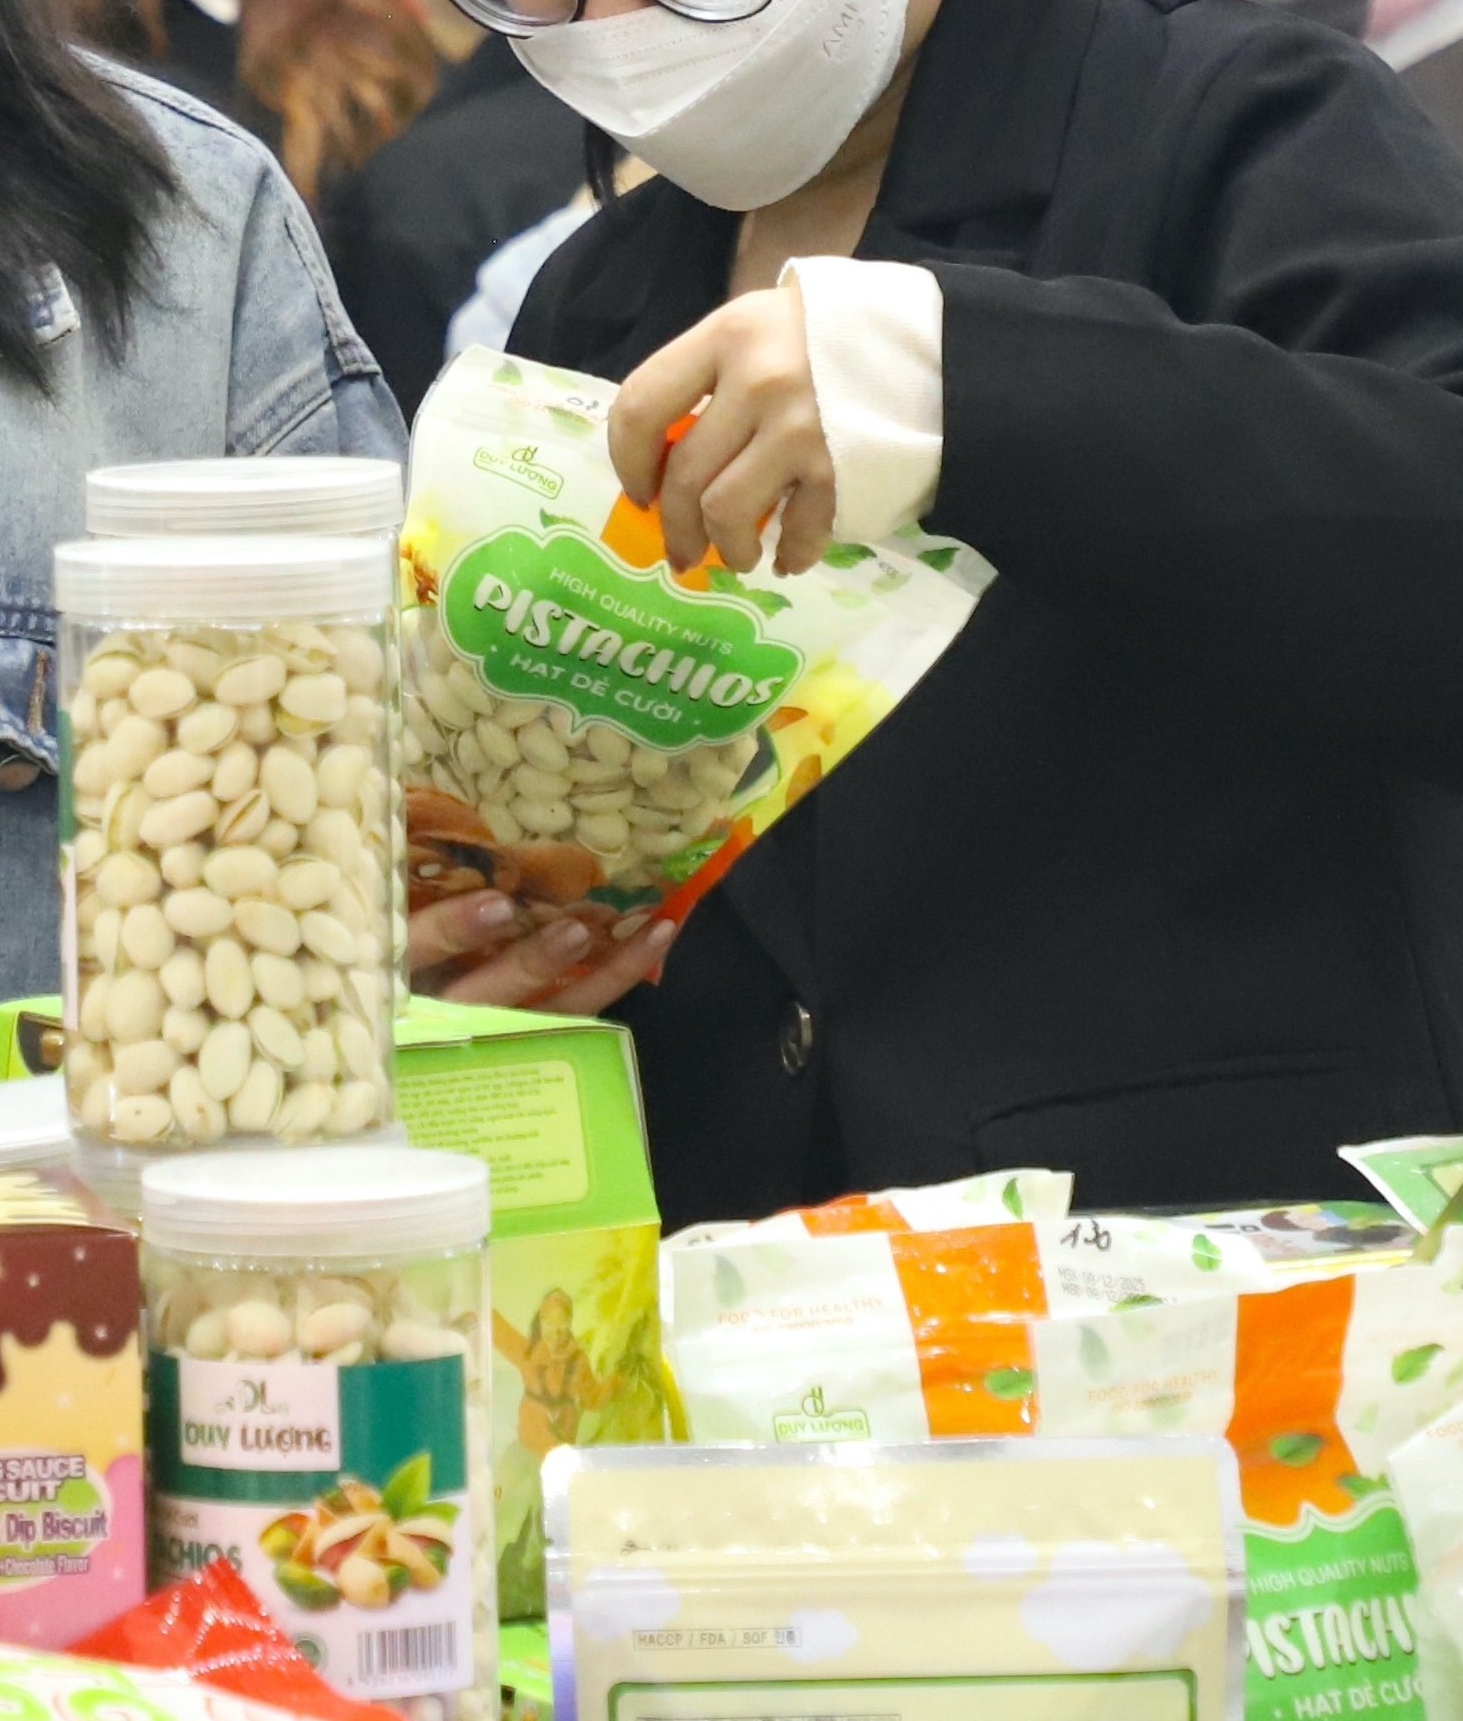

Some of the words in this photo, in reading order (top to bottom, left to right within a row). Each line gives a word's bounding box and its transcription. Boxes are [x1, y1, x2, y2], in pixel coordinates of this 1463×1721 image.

[550, 567, 596, 601] HIGH
[599, 593, 678, 637] QUALITY
[683, 628, 734, 656] NUTS
[473, 573, 784, 708] PISTACHIOS
[808, 1296, 884, 1316] HEALTHY
[4, 1454, 87, 1480] SAUCE
[5, 1512, 37, 1550] Dip
[41, 1509, 109, 1541] Biscuit
[1249, 1571, 1297, 1596] HIGH
[1299, 1556, 1368, 1587] QUALITY
[1369, 1550, 1410, 1574] NUTS
[637, 1633, 684, 1646] HACCP
[699, 1632, 725, 1645] FDA
